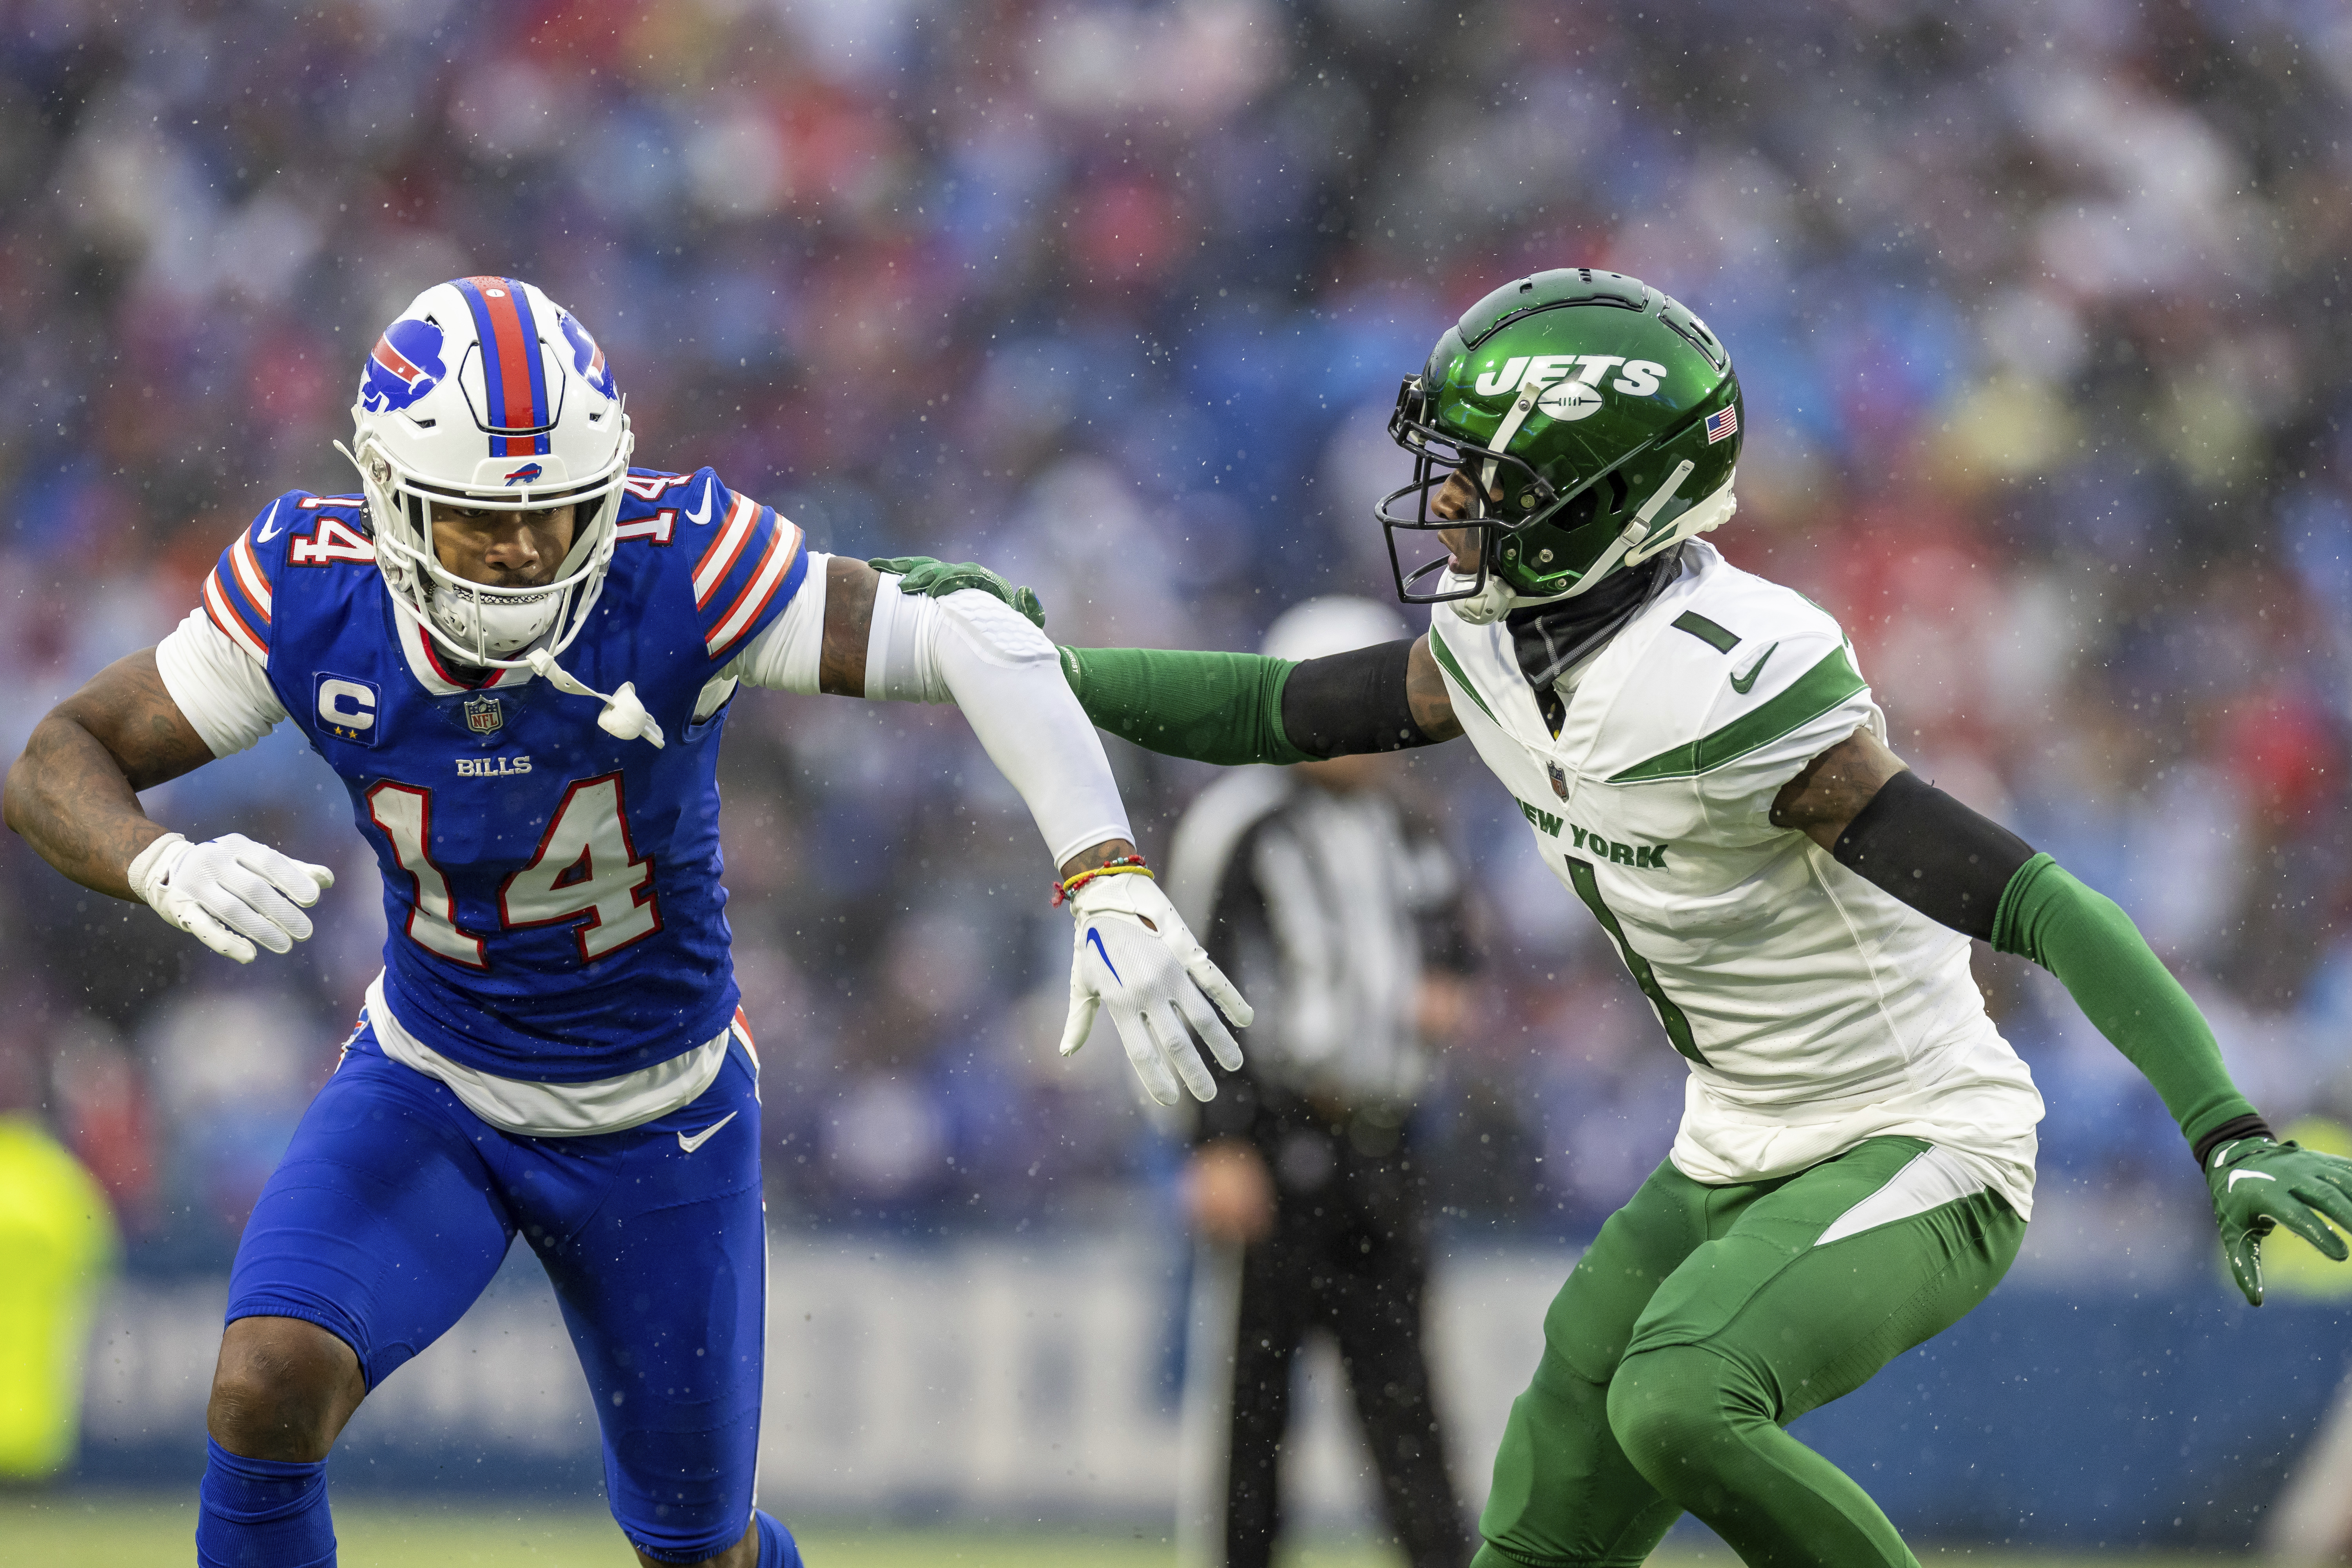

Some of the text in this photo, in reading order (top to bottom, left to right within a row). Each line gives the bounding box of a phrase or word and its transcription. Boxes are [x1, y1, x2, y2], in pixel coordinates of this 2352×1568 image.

[1474, 355, 1668, 396] JETS
[1670, 609, 1742, 655] 1
[1066, 651, 1078, 674] CHRIST
[319, 679, 375, 730] C
[472, 713, 497, 728] NFL
[455, 756, 532, 777] BILLS
[1570, 823, 1668, 869] YORK
[364, 769, 664, 973] 14
[1564, 854, 1714, 1069] 1
